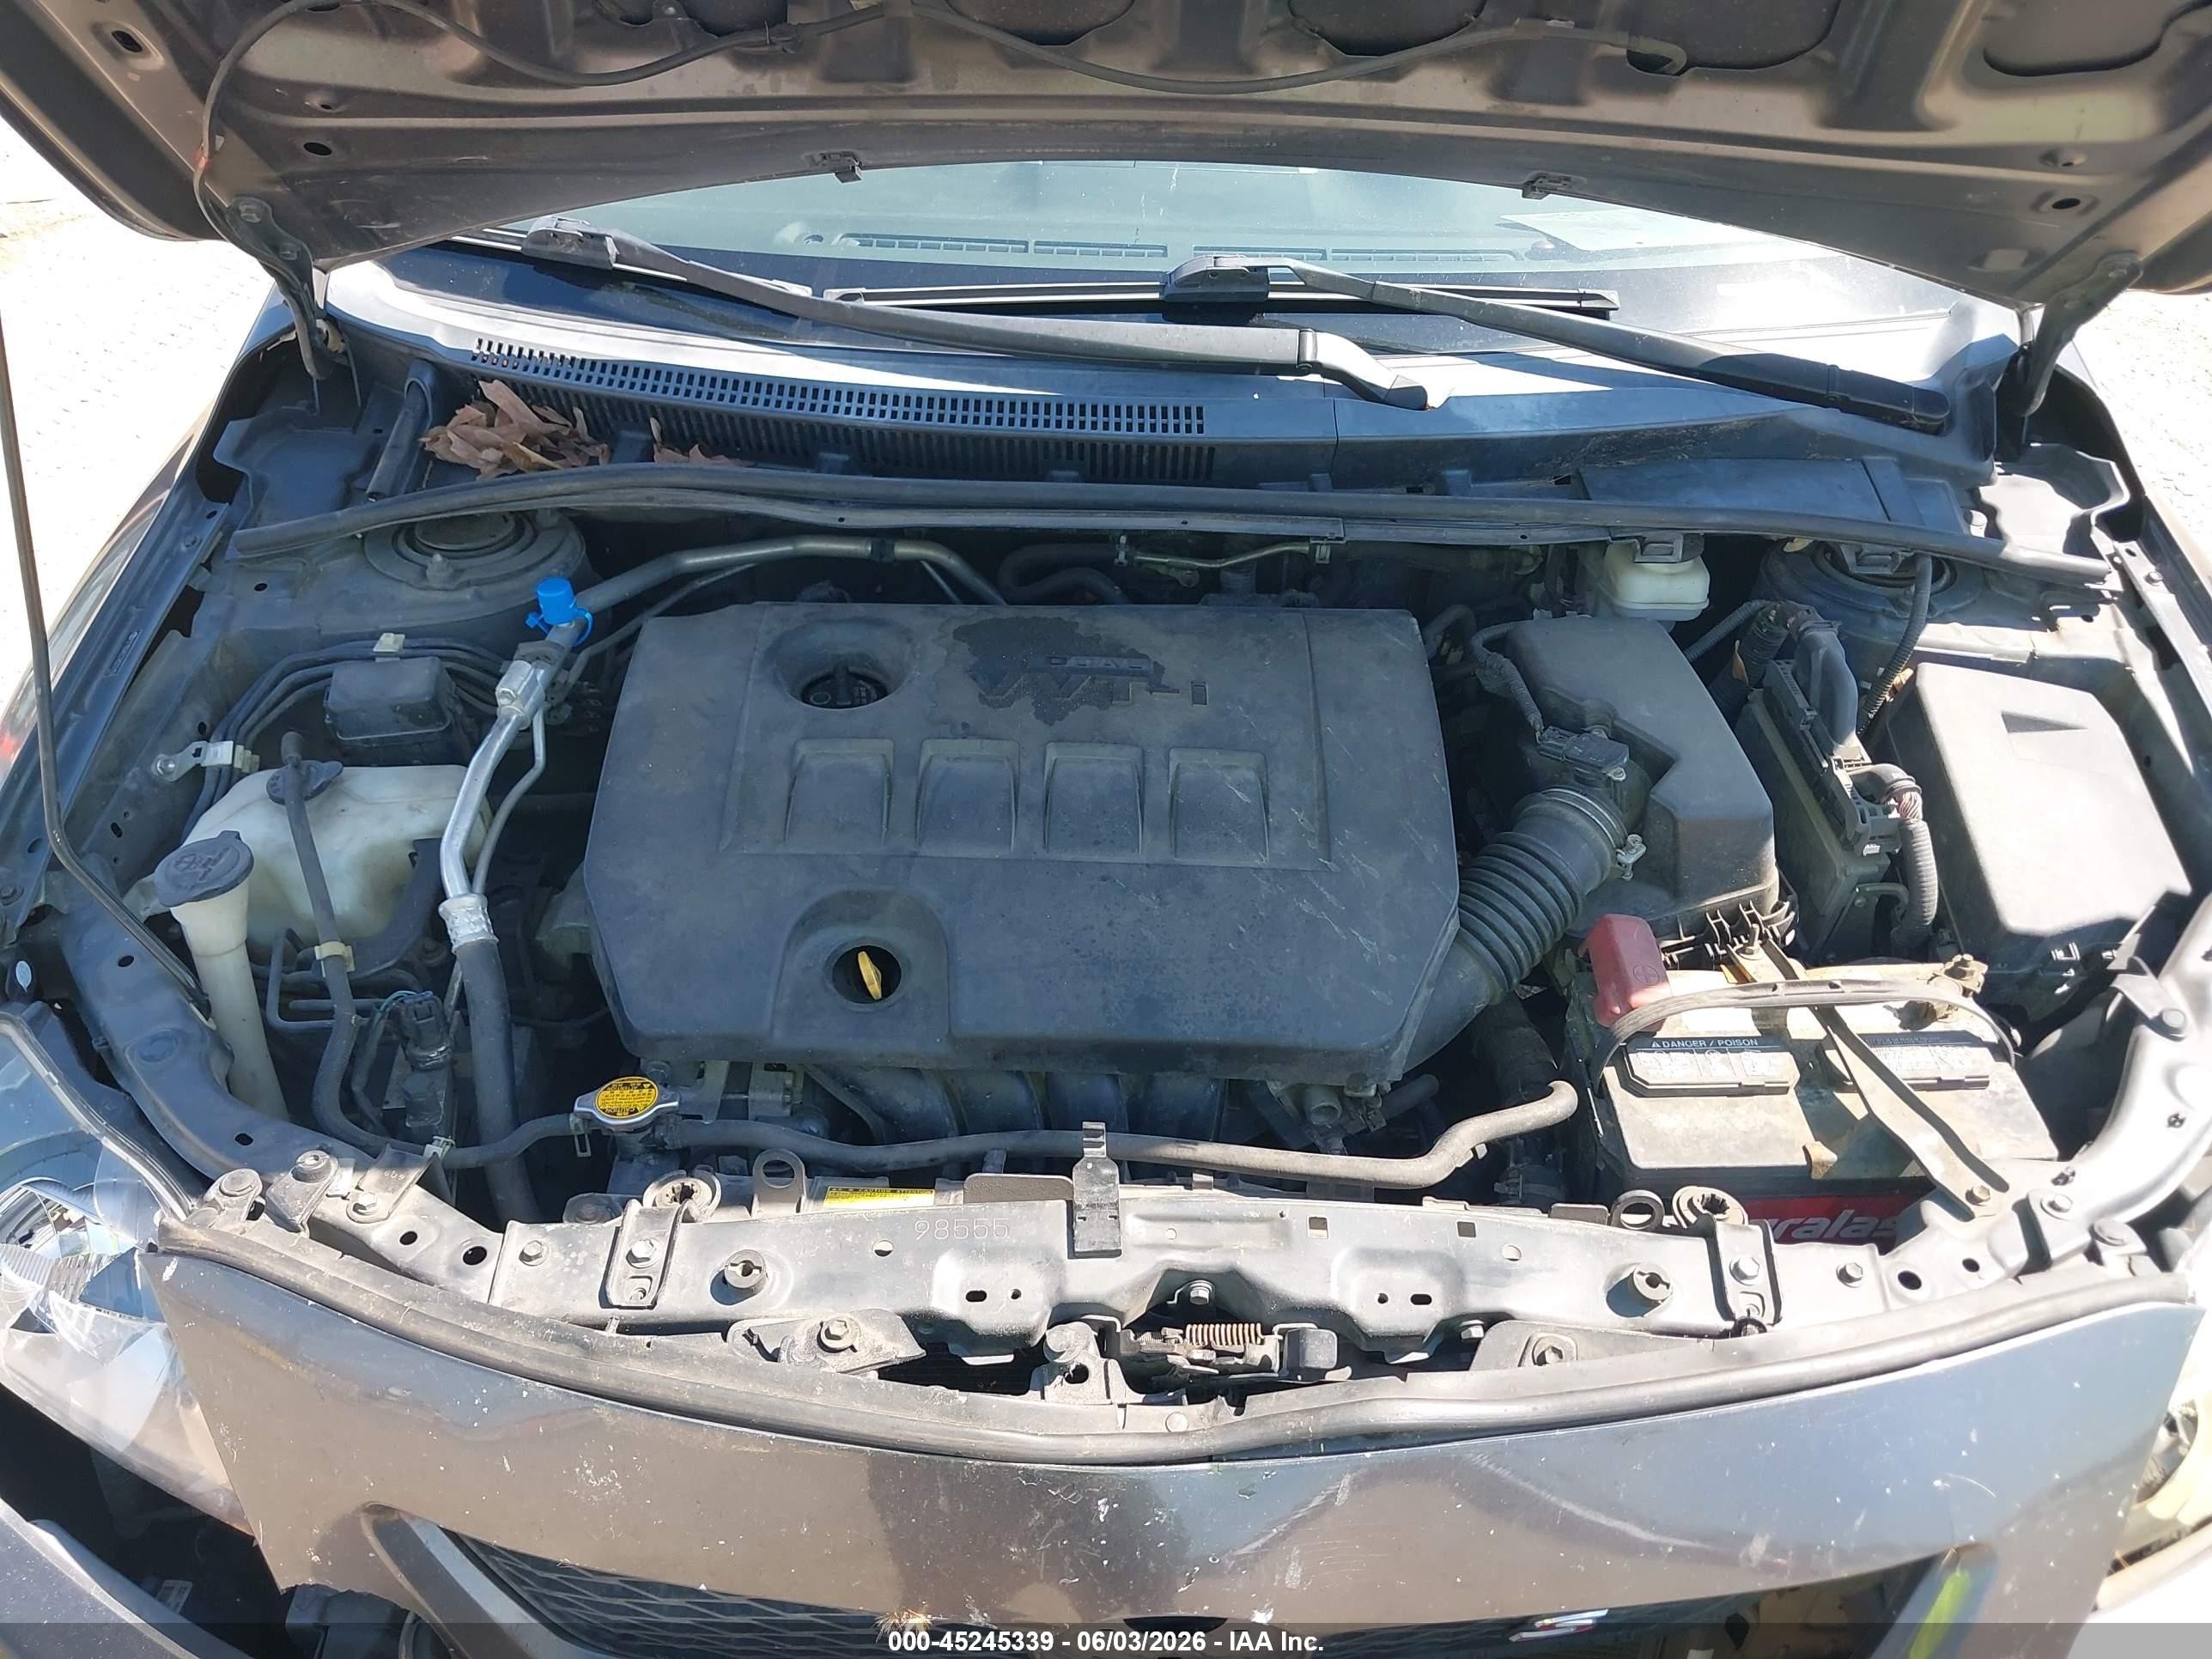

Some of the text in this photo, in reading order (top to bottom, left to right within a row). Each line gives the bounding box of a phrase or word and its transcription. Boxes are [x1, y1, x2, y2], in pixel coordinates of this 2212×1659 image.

[1662, 1039, 1706, 1048] DANGER
[1717, 1038, 1759, 1047] POISON
[915, 1218, 1010, 1240] 98555
